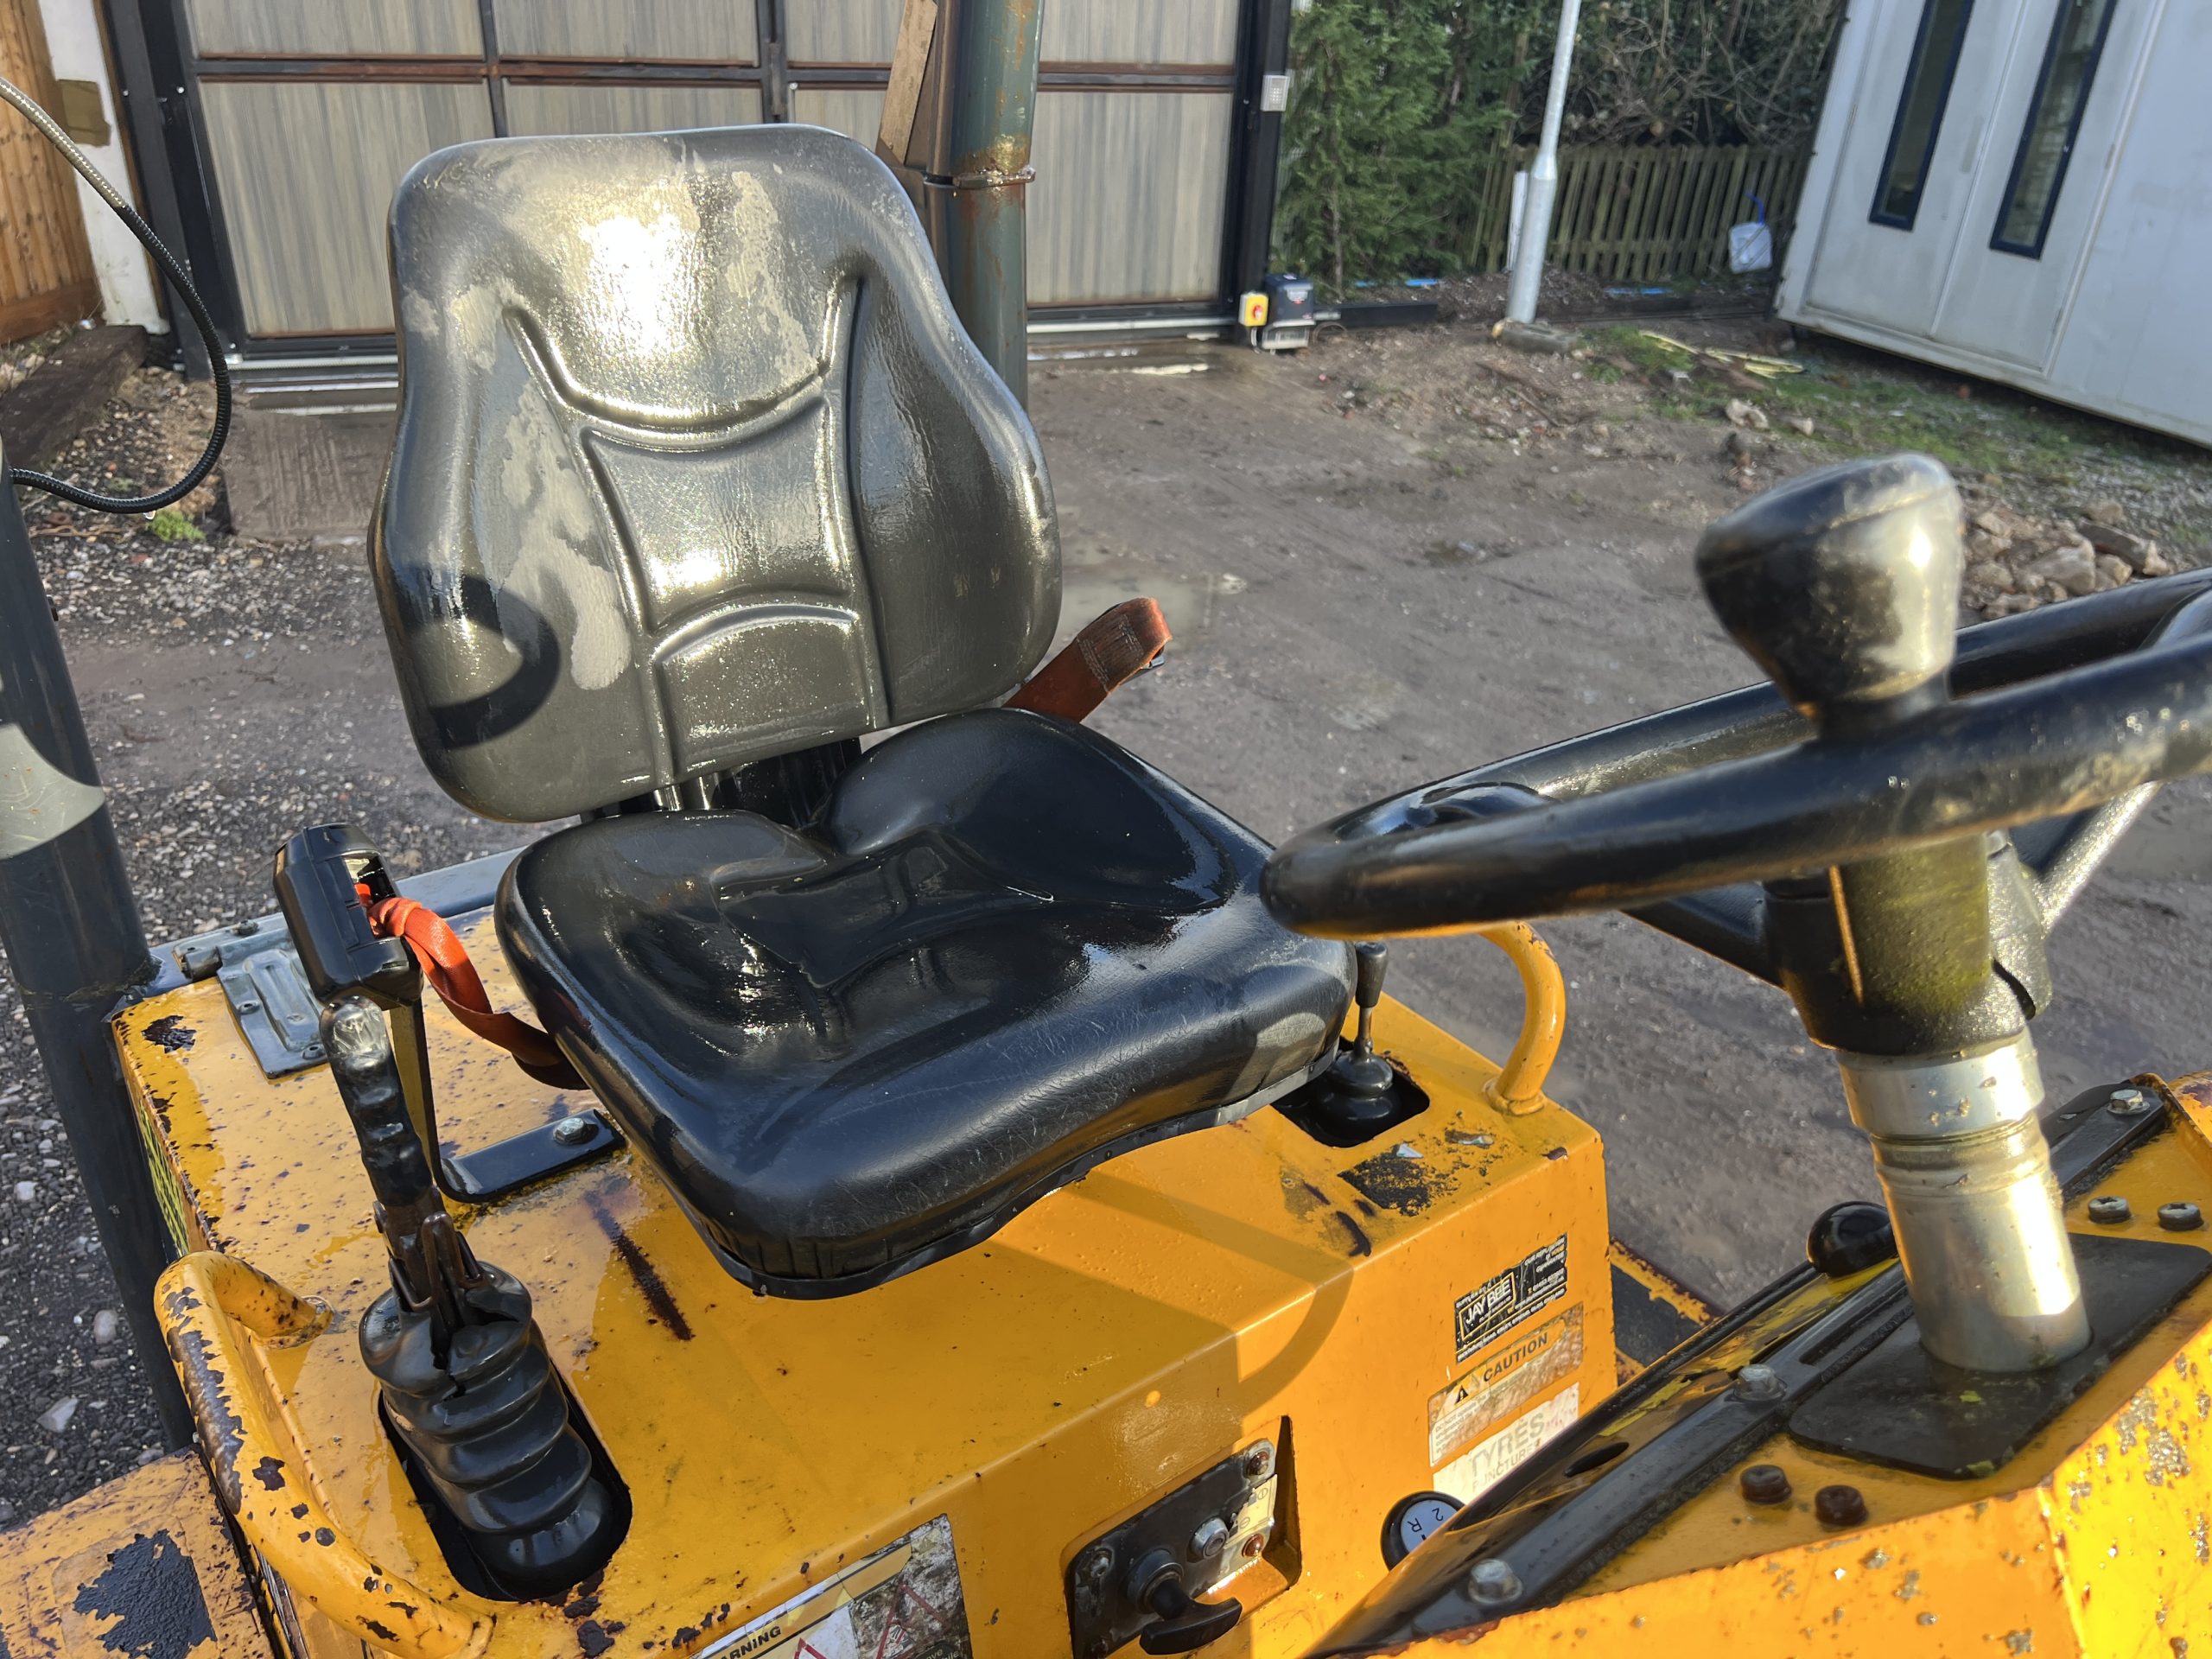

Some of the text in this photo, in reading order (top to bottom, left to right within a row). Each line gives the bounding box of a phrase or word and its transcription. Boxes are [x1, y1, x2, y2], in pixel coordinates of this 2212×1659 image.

[1465, 1296, 1486, 1325] JAY
[1486, 1279, 1512, 1308] BEE
[1484, 1332, 1548, 1382] CAUTION
[1470, 1412, 1545, 1478] TYRES
[1407, 1517, 1423, 1533] R
[1432, 1507, 1444, 1522] 2
